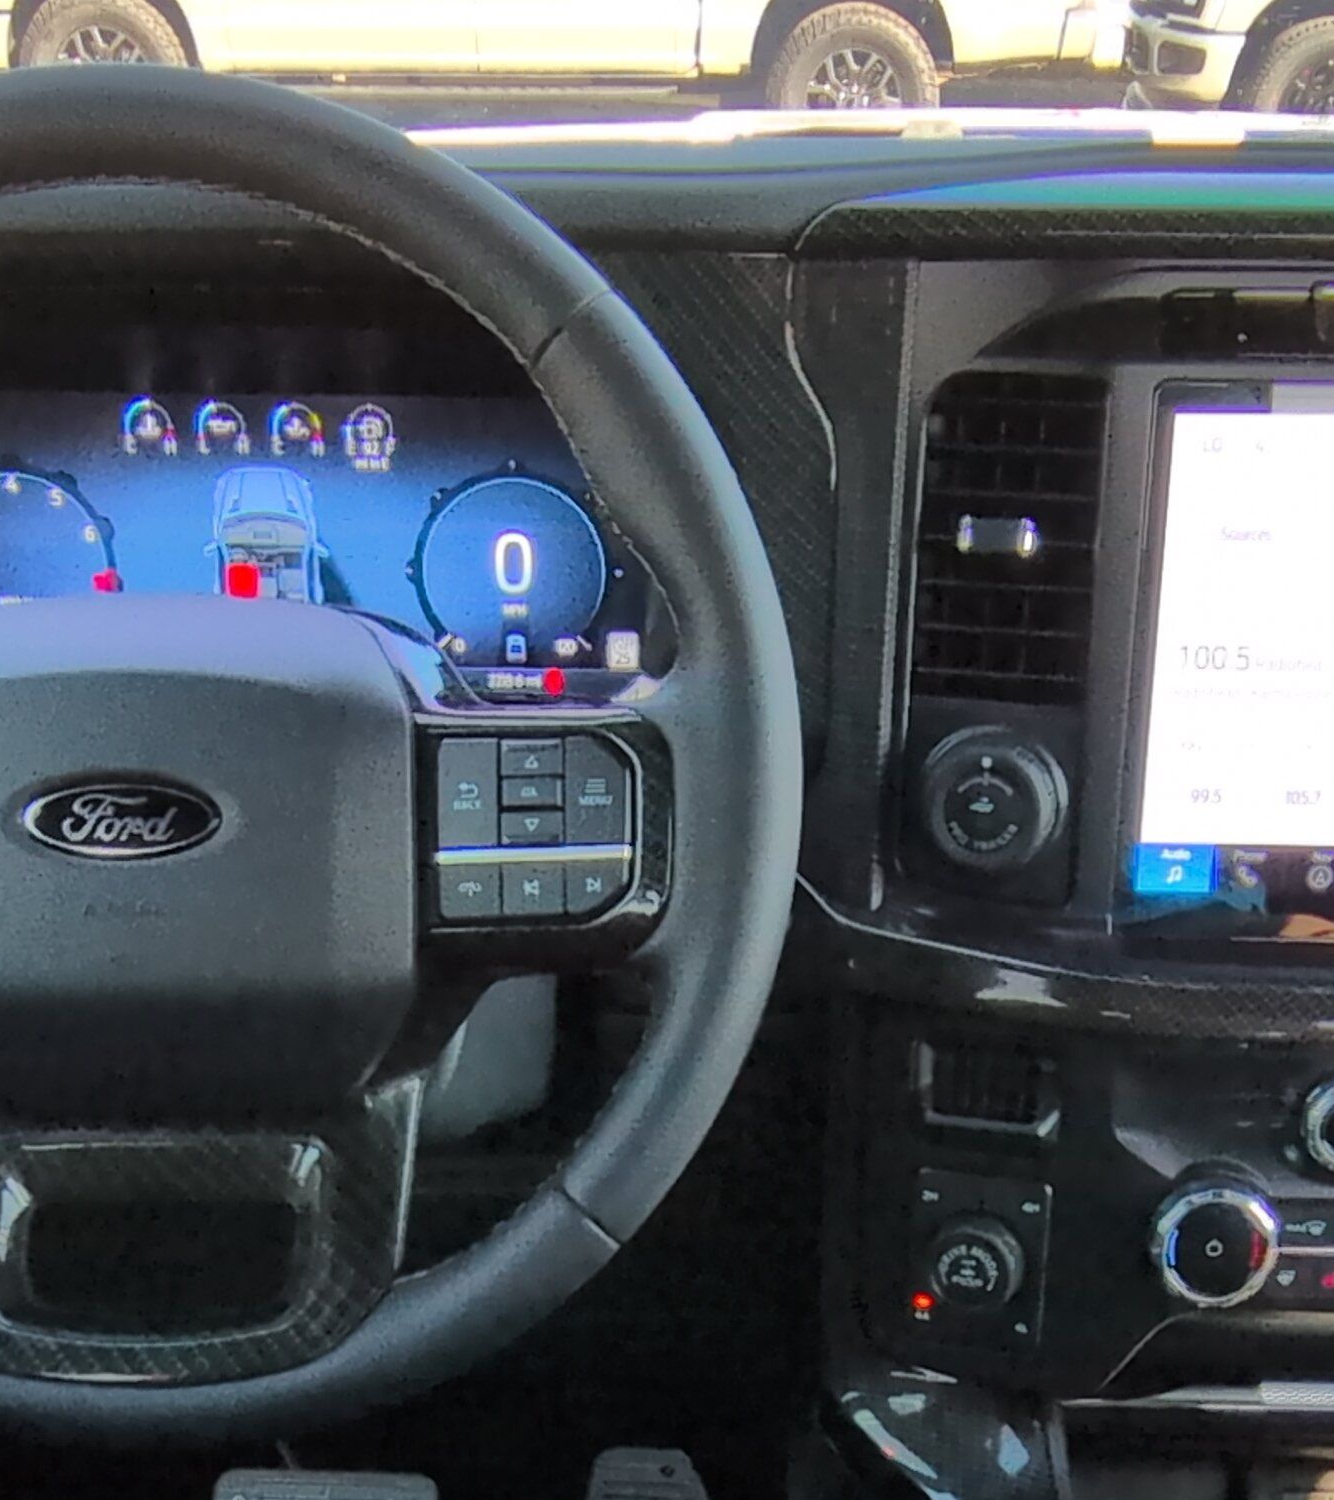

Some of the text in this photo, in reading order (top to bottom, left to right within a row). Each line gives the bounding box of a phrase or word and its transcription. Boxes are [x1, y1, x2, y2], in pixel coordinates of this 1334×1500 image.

[49, 488, 65, 508] 5
[83, 524, 98, 544] 6
[495, 533, 533, 594] 0
[578, 795, 613, 806] MENU
[1190, 788, 1223, 804] 99.5
[1285, 790, 1322, 806] 105.7
[453, 800, 482, 811] BACK
[61, 792, 179, 843] Ford
